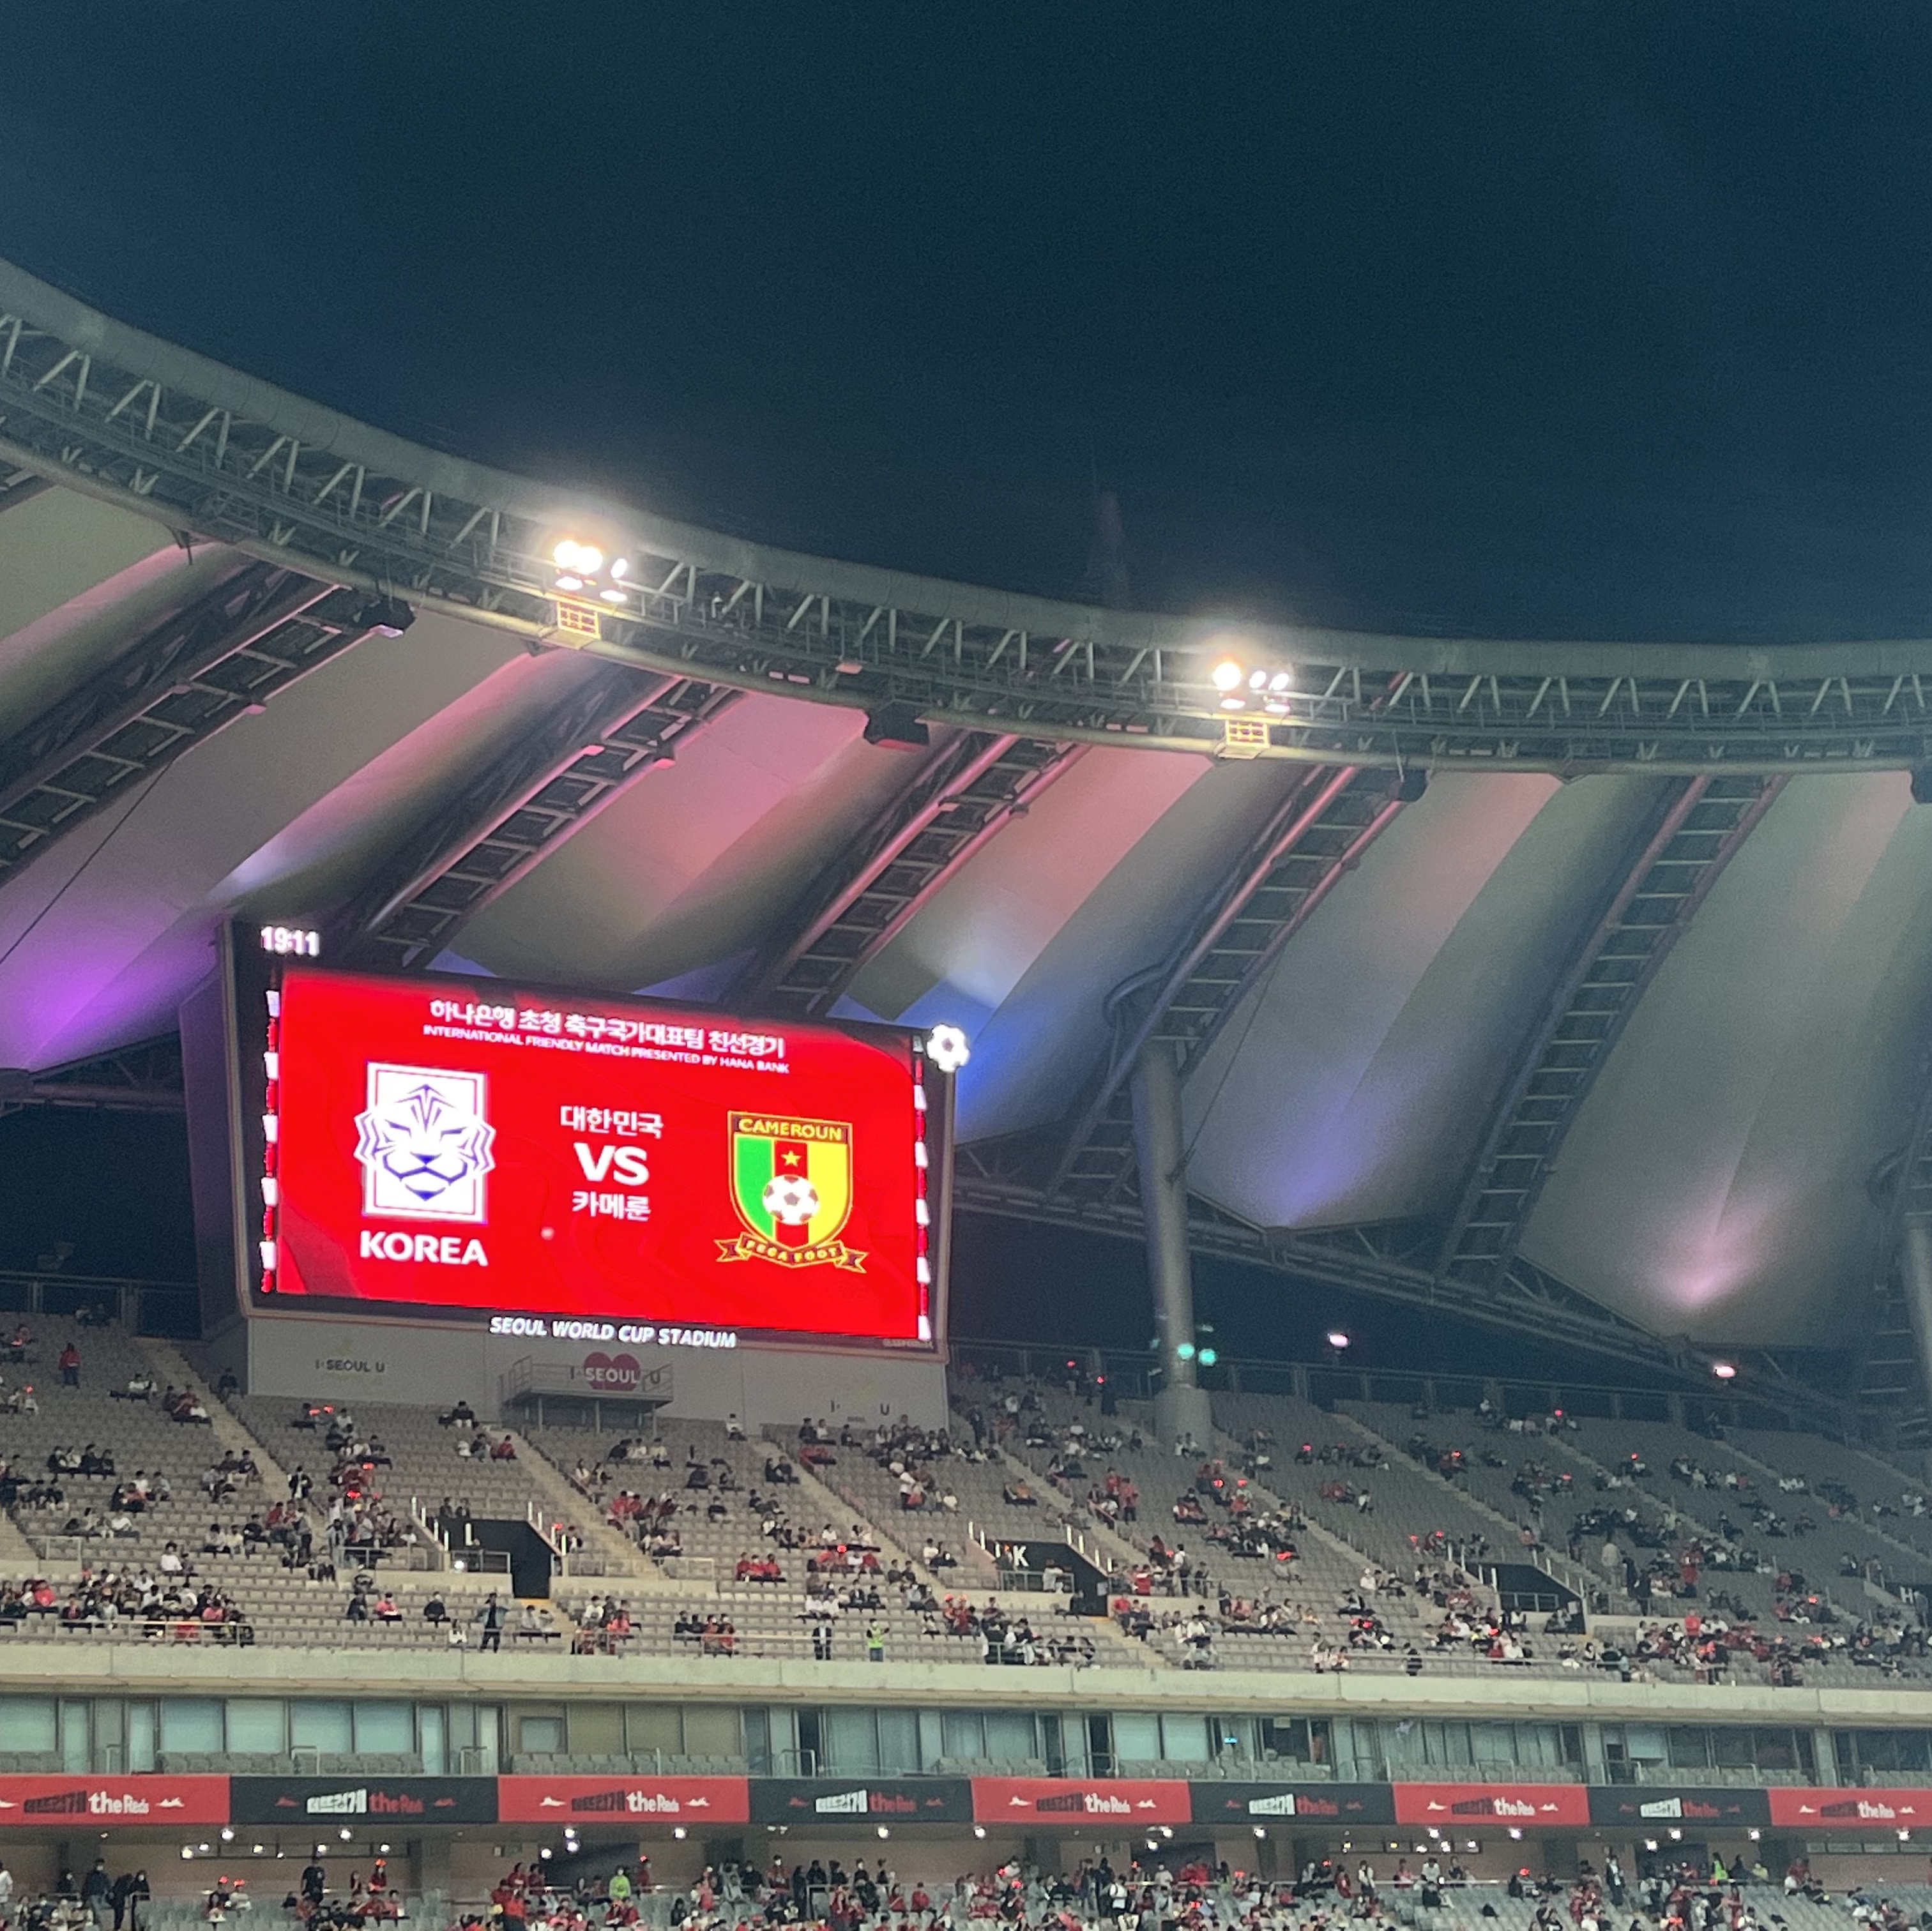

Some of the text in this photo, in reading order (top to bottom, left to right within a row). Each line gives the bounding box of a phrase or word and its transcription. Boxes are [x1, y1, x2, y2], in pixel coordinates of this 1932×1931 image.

[261, 926, 319, 957] 19:11
[430, 999, 785, 1059] 하나은행 초청 축구국가대표팀 친선경기
[423, 1024, 790, 1073] INTERNATIONAL FRIENDLY MATCH PRESENTED BY HANA BANK
[560, 1105, 664, 1139] 대한민국
[738, 1118, 842, 1140] CAMEROUN
[573, 1142, 650, 1186] VS
[572, 1190, 651, 1222] 카메룬
[360, 1230, 489, 1266] KOREA
[489, 1317, 736, 1348] SEOUL WORLD CUP STADIUM
[326, 1359, 371, 1372] SEOUL
[585, 1367, 637, 1383] SEOUL
[1012, 1545, 1030, 1566] K
